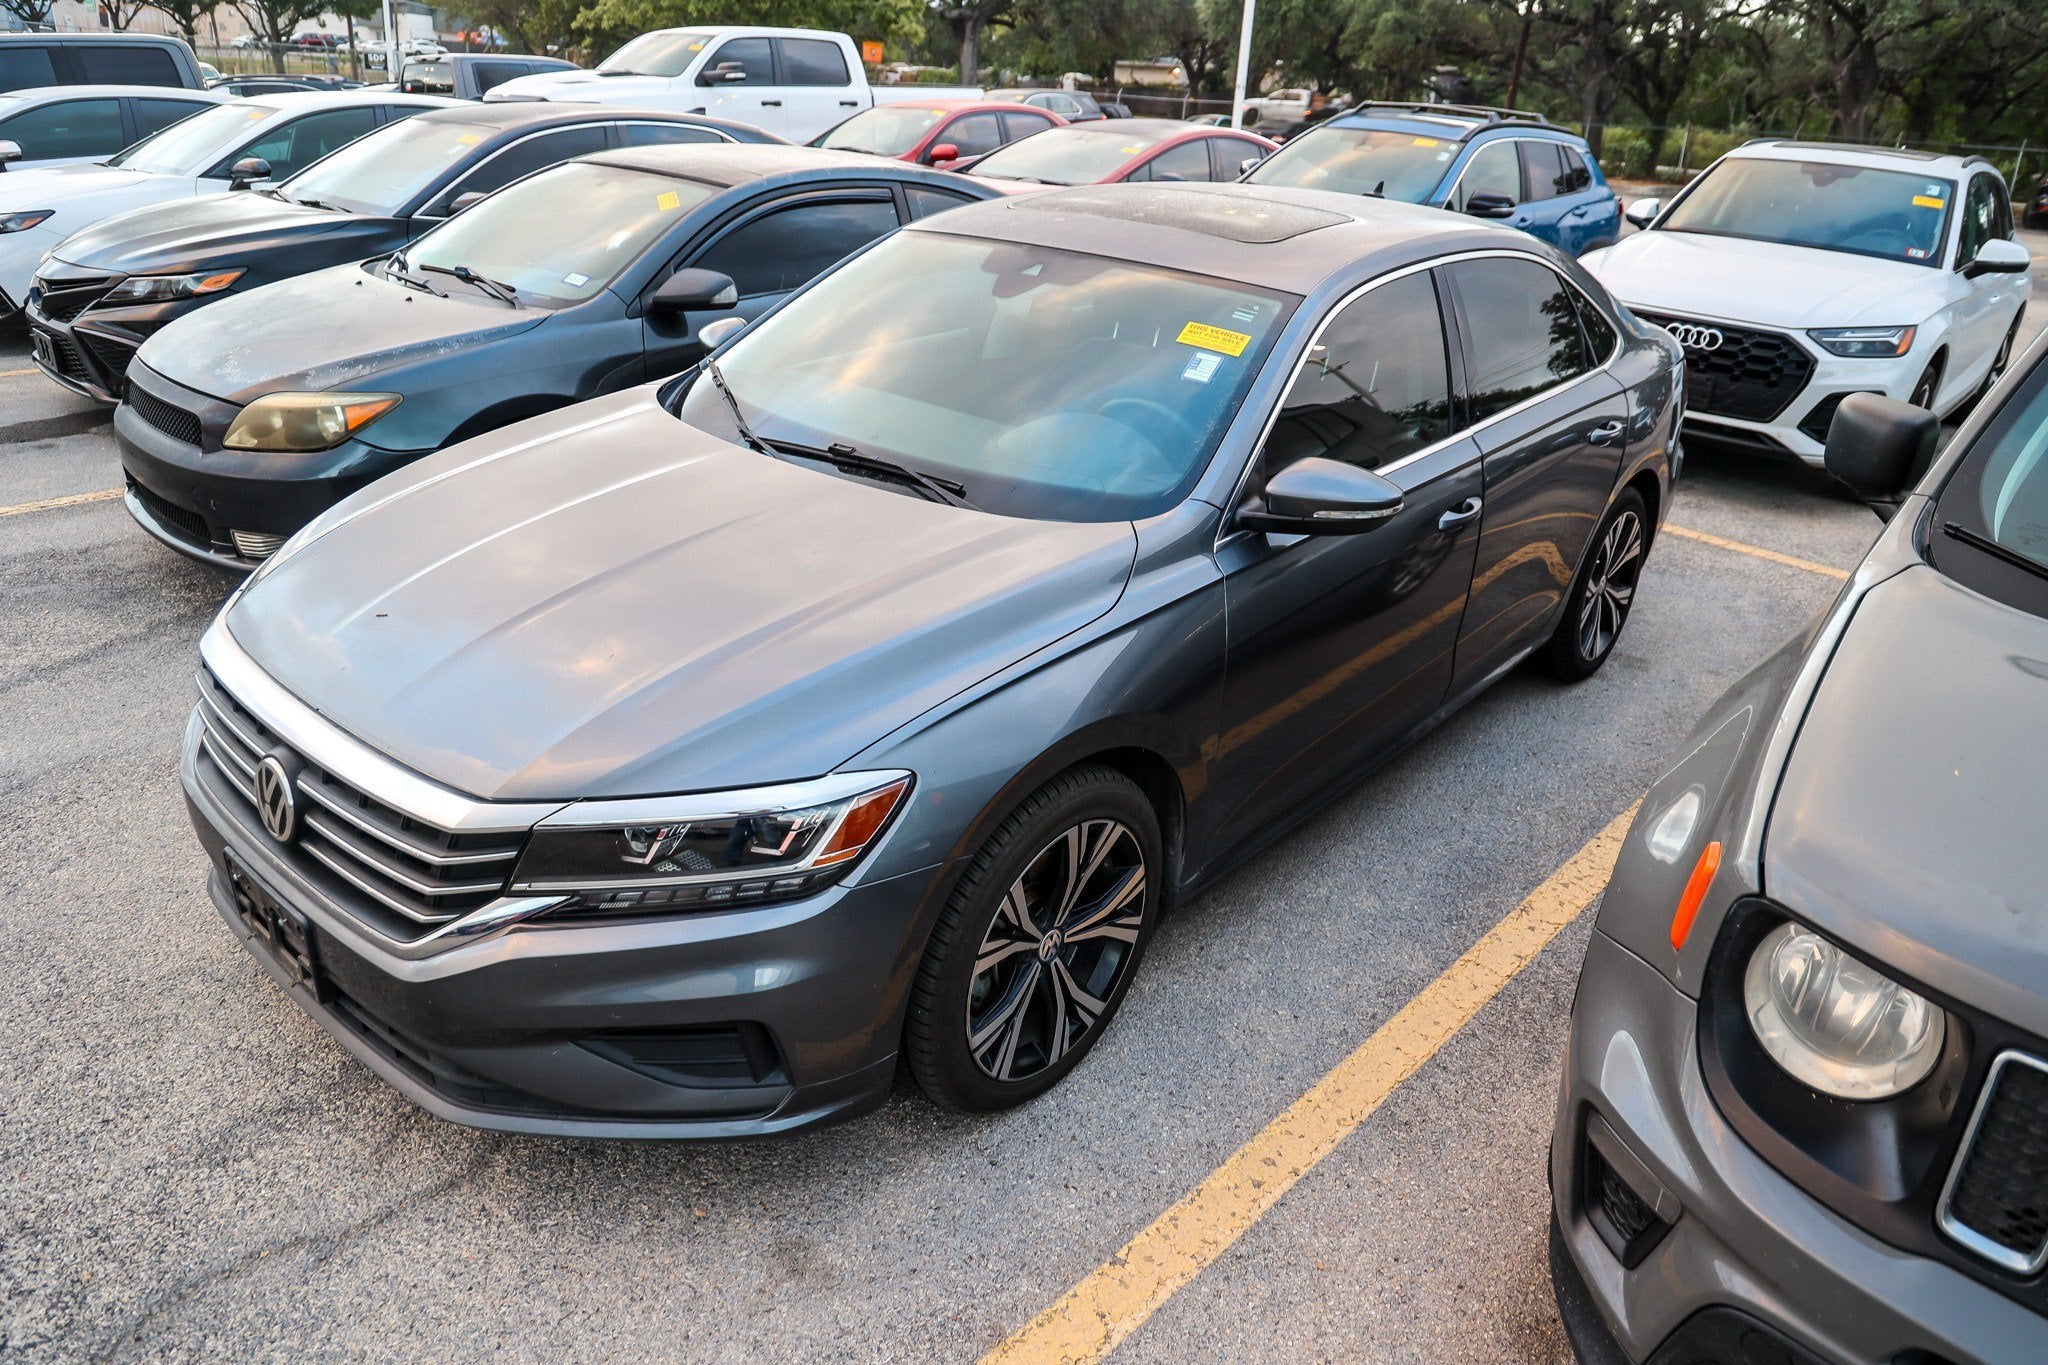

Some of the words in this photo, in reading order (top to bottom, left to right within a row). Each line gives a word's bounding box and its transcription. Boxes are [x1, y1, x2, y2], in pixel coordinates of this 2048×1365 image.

[1190, 324, 1208, 332] THIS
[1210, 329, 1246, 341] VEHICLE
[1221, 336, 1241, 345] SALE
[258, 758, 292, 840] VW
